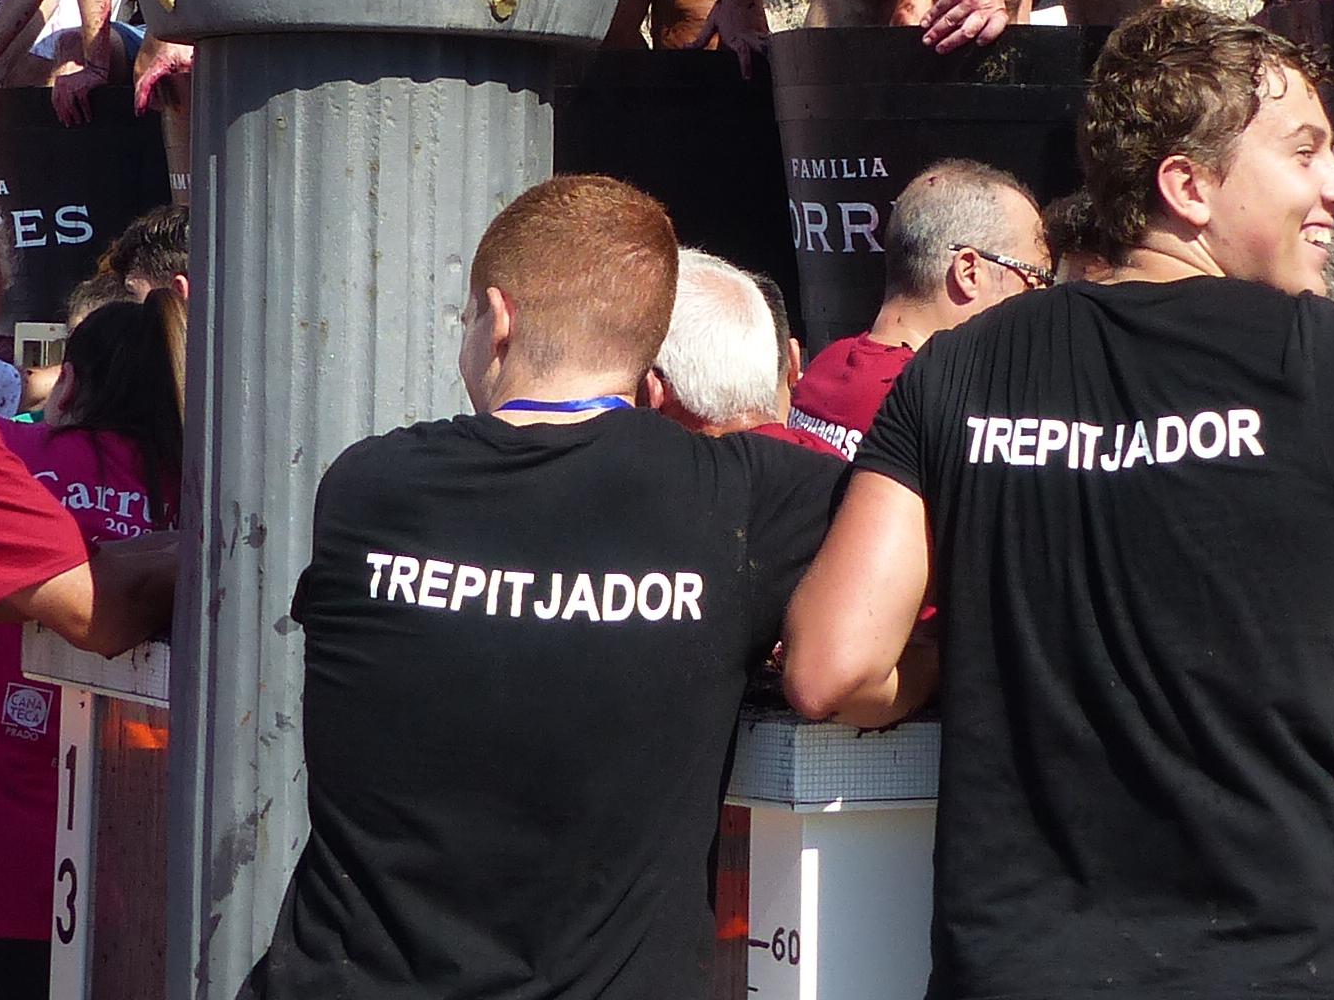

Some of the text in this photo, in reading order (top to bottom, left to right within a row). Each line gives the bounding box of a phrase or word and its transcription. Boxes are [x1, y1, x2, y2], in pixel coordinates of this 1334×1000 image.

[791, 157, 889, 179] FAMILIA
[966, 408, 1265, 472] TREPITJADOR
[366, 552, 703, 622] TREPITJADOR
[771, 927, 801, 965] 60
